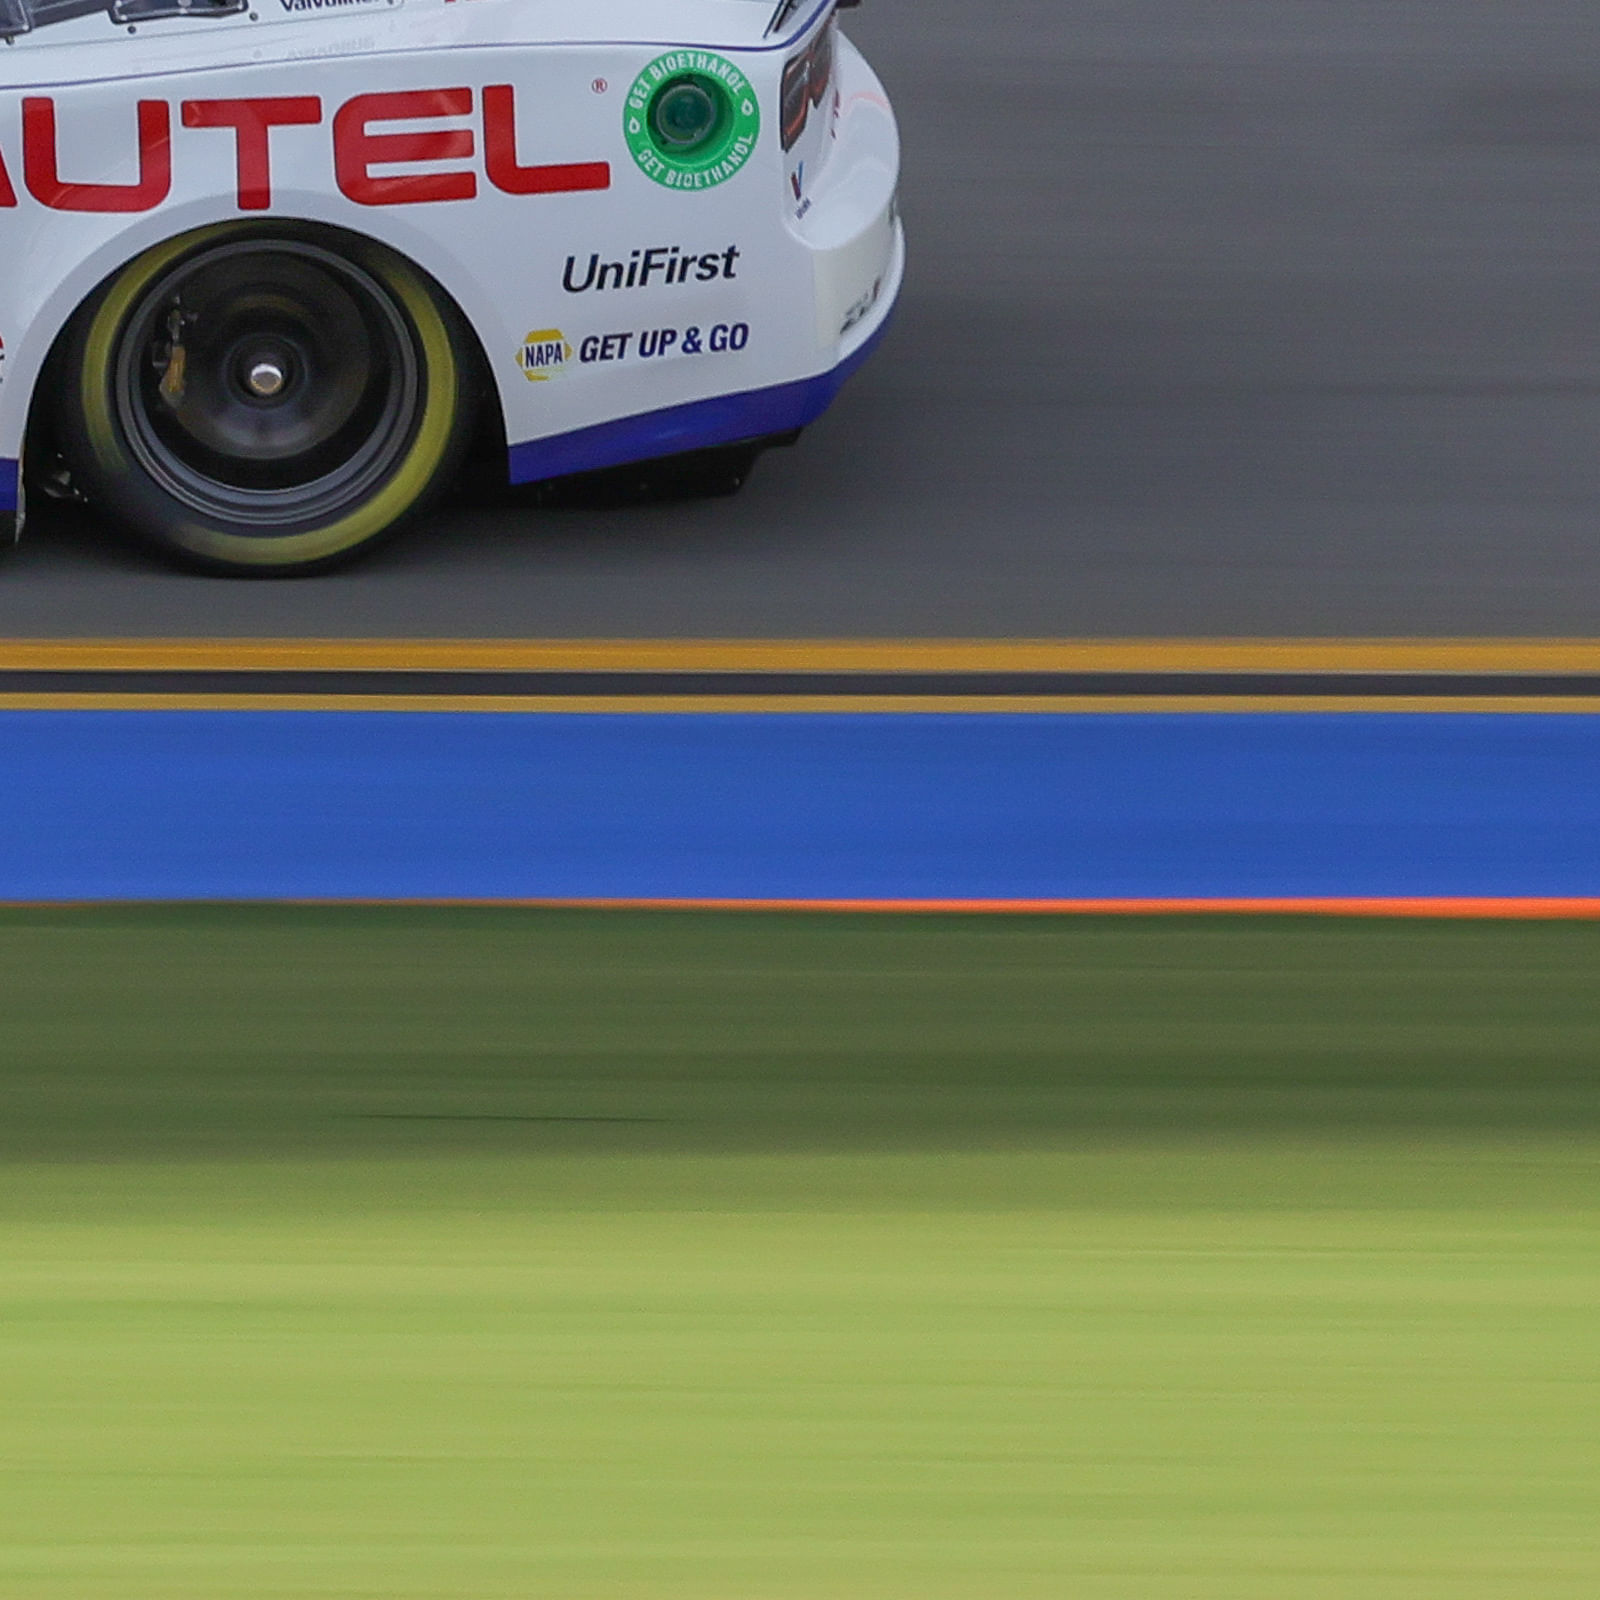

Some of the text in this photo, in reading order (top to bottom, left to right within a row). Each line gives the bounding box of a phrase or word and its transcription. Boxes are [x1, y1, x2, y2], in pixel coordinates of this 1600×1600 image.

[629, 52, 746, 110] GET BIOETHANOL
[637, 133, 754, 188] GET BIOETHANOL
[562, 245, 740, 293] UniFirst
[525, 342, 564, 368] NAPA
[579, 323, 749, 362] GET UP & GO
